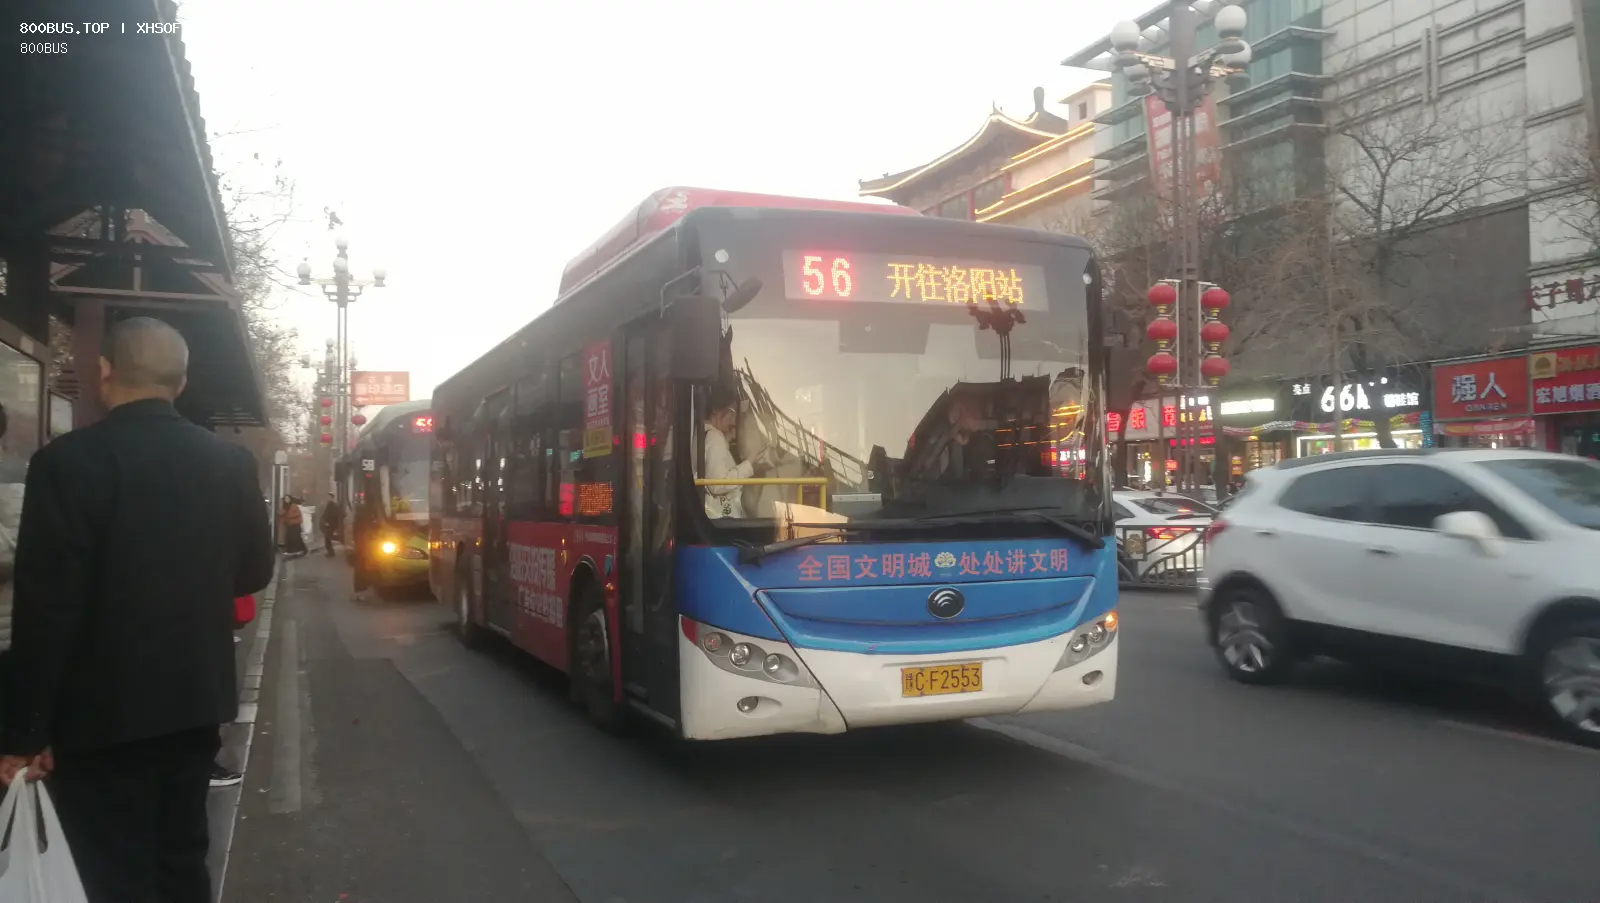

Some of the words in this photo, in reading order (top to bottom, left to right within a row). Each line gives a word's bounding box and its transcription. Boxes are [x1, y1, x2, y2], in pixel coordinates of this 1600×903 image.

[802, 255, 852, 298] 56
[886, 262, 1025, 305] 开往洛阳站
[796, 551, 933, 582] 全国文明城
[959, 547, 1070, 576] 处处讲文明
